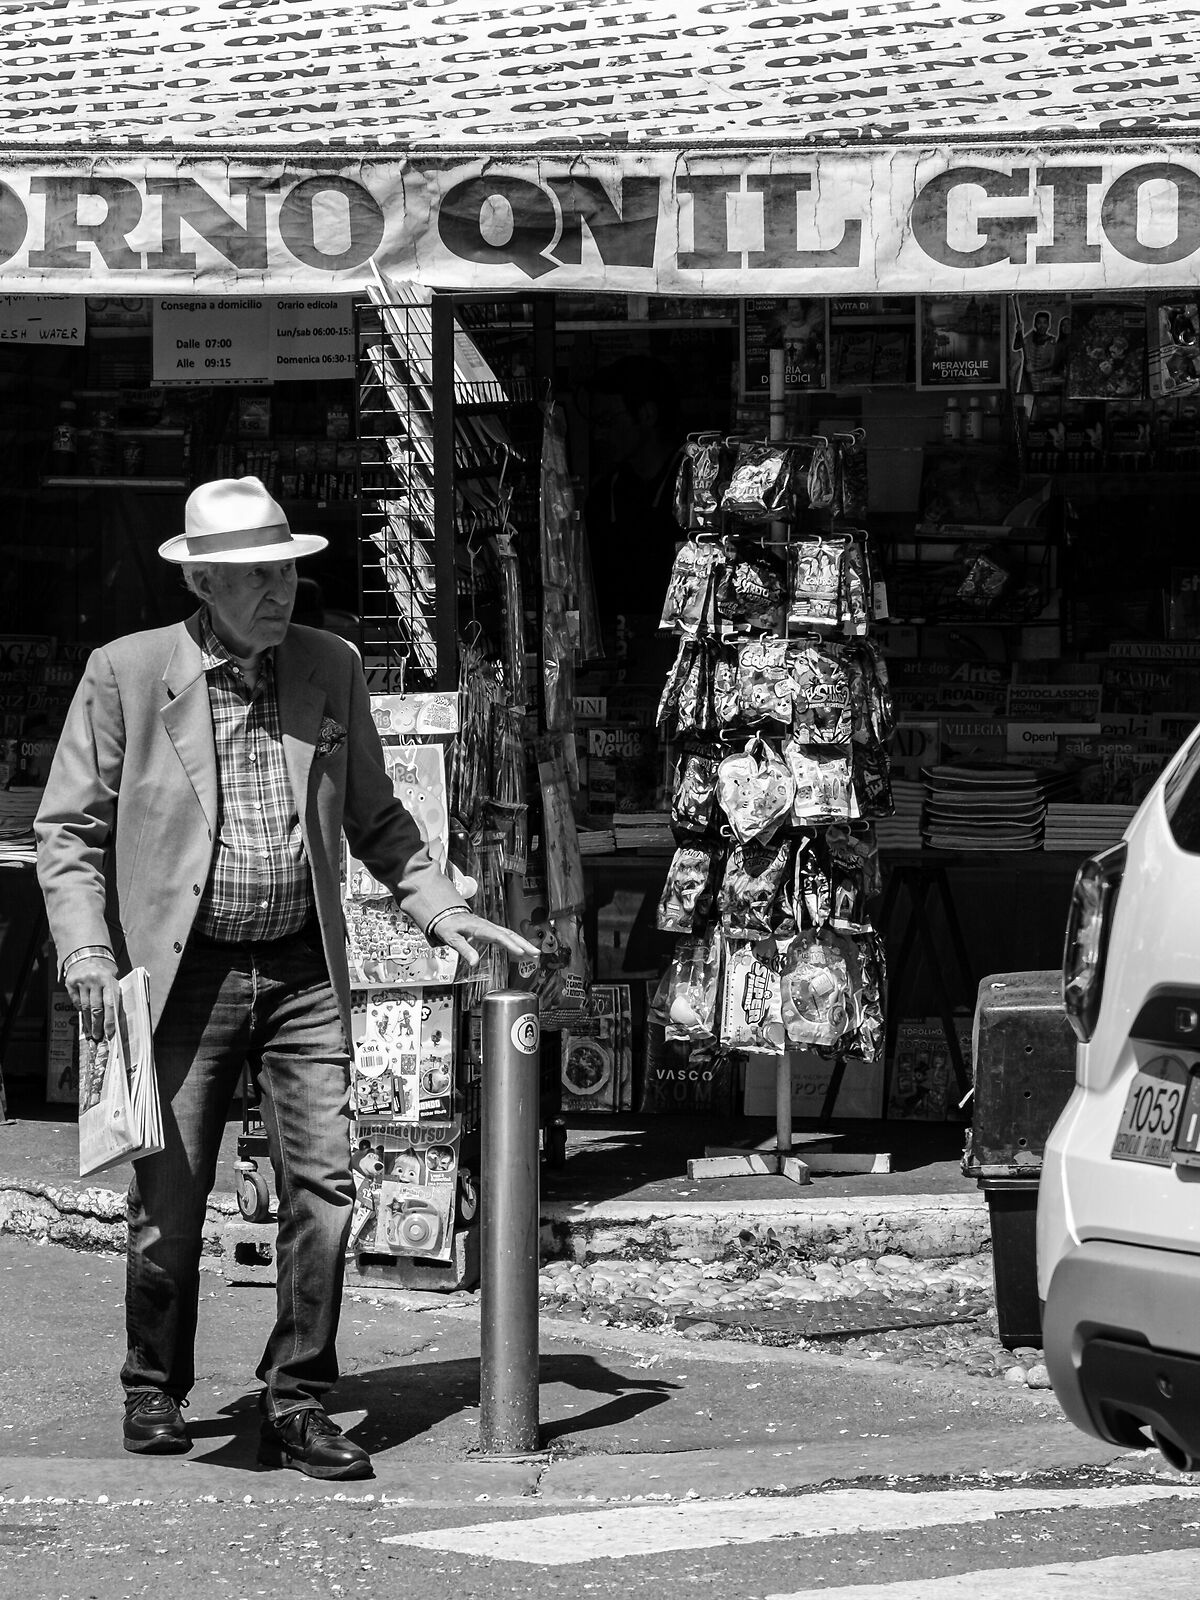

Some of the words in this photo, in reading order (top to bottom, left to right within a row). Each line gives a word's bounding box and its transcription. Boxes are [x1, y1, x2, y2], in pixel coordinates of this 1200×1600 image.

[714, 13, 1005, 53] GIORNO
[185, 34, 468, 68] GIORNO
[442, 25, 728, 63] GIORNO
[729, 53, 1028, 91] GIORNO
[189, 72, 479, 103] GIORNO
[451, 64, 745, 99] GIORNO
[747, 90, 1052, 126] GIORNO
[194, 108, 490, 137] GIORNO
[462, 101, 762, 134] GIORNO
[161, 301, 207, 312] Consegna
[217, 300, 263, 310] domicilio
[277, 301, 305, 310] Orario
[307, 301, 338, 310] edicola
[39, 327, 78, 339] WATER
[276, 328, 311, 338] Lun/sab
[176, 339, 200, 349] Dalle
[205, 338, 232, 349] 07:00
[176, 358, 195, 368] Alle
[204, 358, 231, 368] 09:15
[276, 354, 320, 365] Domenica
[932, 360, 989, 371] MERAVIGLIE
[941, 369, 980, 378] D'ITALIA
[43, 667, 74, 682] Bio
[950, 662, 1001, 683] Arte
[1065, 742, 1092, 755] sale
[1098, 742, 1133, 758] pepe
[656, 1069, 713, 1081] VASCO
[1129, 1085, 1180, 1136] 1053
